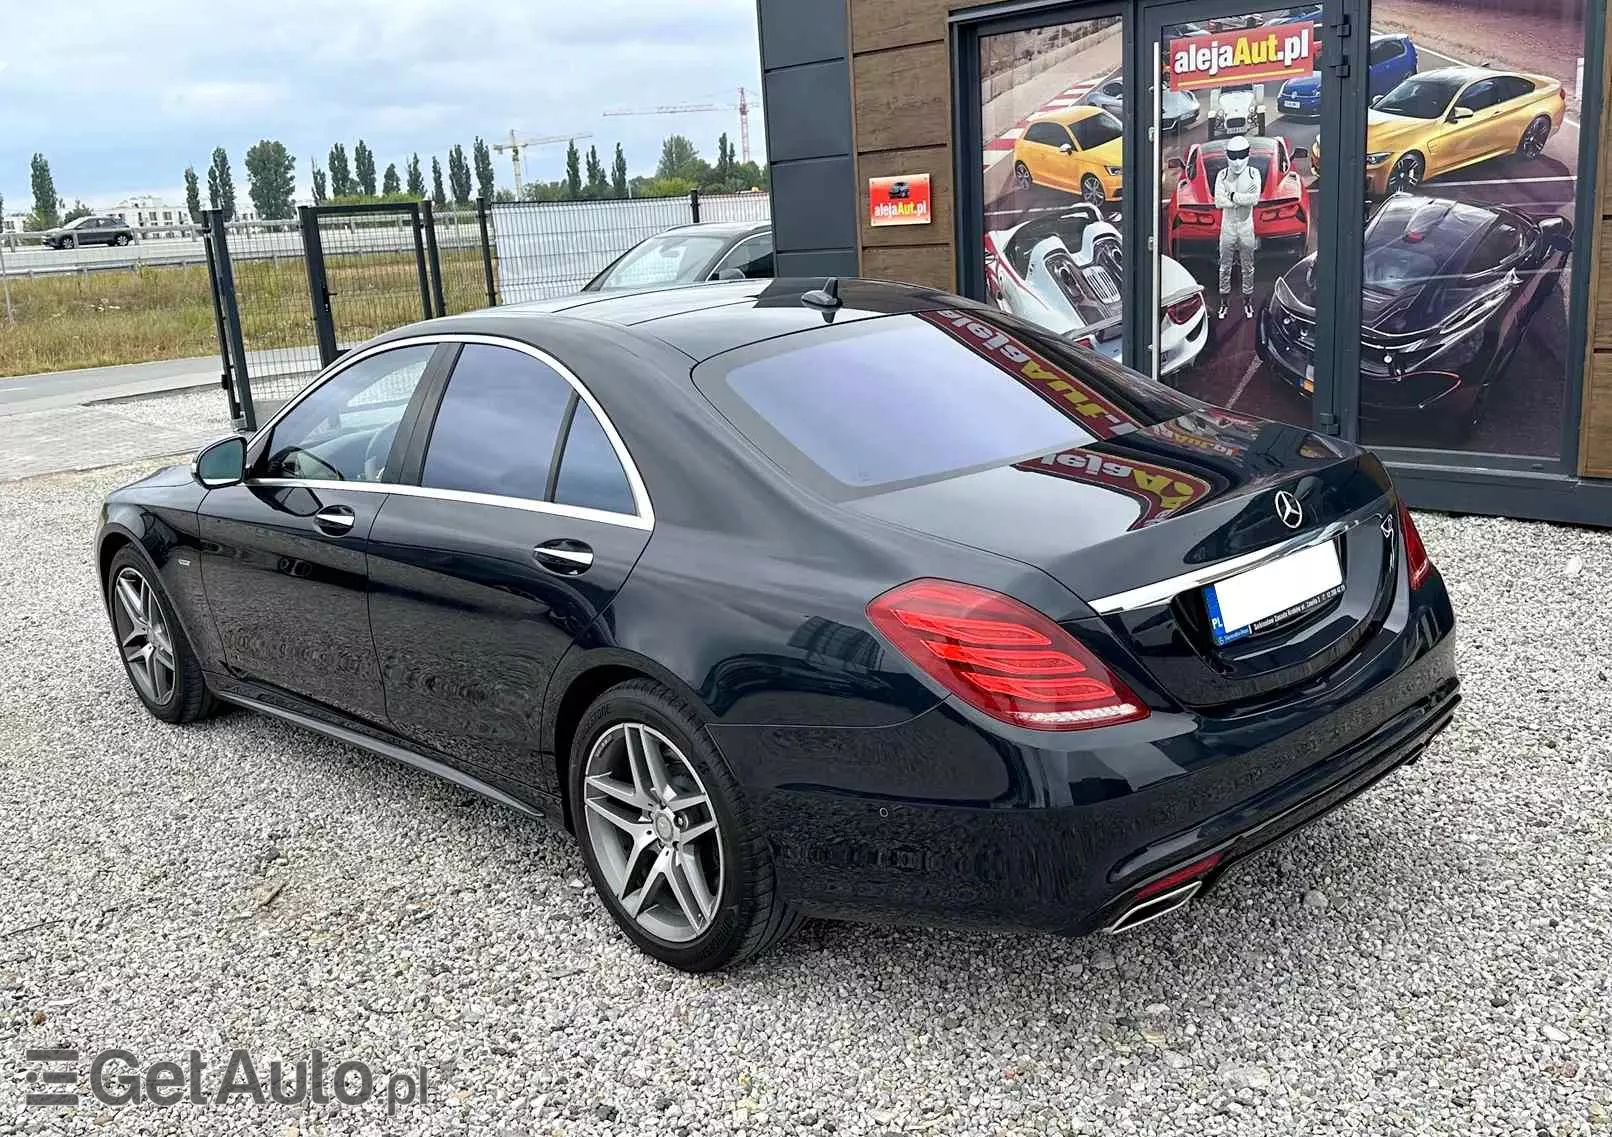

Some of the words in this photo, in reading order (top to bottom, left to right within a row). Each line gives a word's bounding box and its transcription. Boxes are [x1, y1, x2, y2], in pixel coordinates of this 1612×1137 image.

[1173, 29, 1309, 76] alejaAut.pl
[874, 200, 927, 218] alejaAut.pl
[1211, 616, 1223, 630] PL
